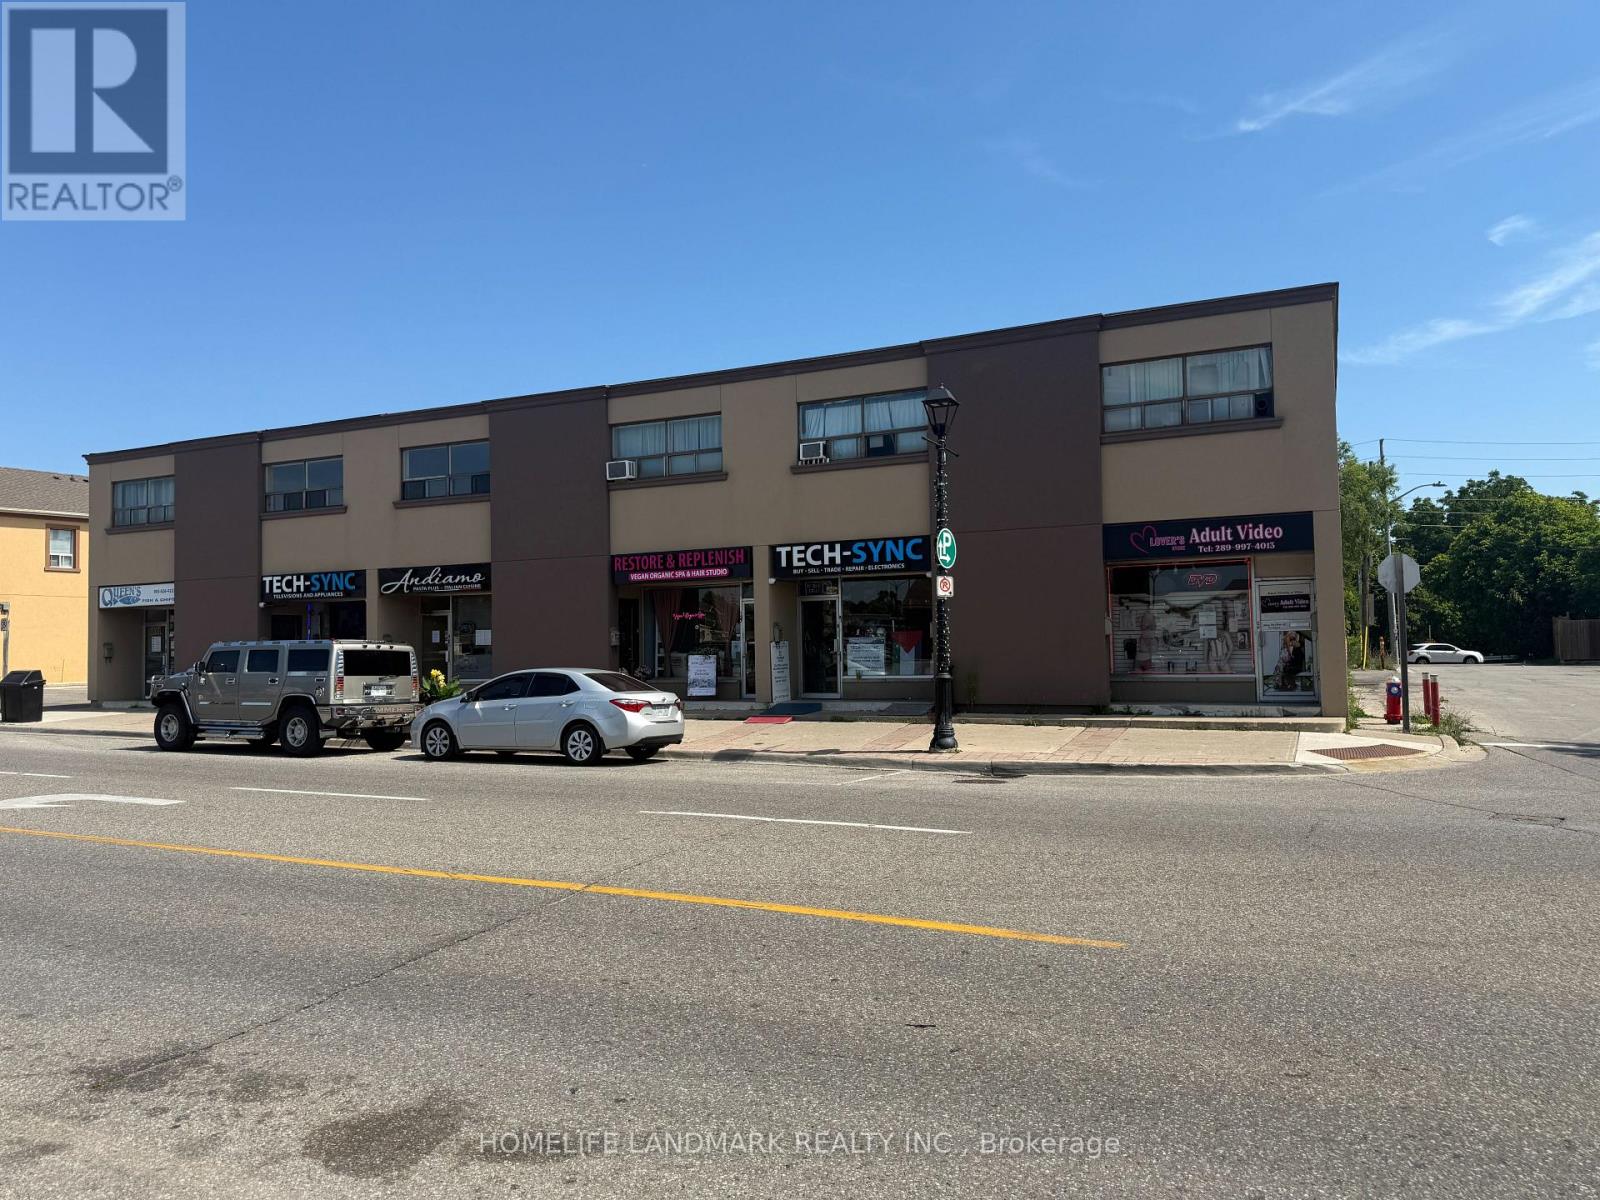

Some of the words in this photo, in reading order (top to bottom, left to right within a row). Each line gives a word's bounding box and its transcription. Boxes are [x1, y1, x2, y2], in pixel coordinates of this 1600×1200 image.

[1150, 535, 1185, 547] LOVER'S
[1189, 526, 1233, 544] Adult
[1236, 523, 1284, 540] Video
[614, 554, 664, 571] RESTORE
[666, 553, 675, 568] &
[678, 548, 745, 567] REPLENISH
[776, 538, 923, 568] TECH-SYNC
[1198, 545, 1214, 553] Tel:
[630, 573, 649, 581] VEGAN
[649, 571, 675, 580] ORGANIC
[675, 570, 686, 578] SPA
[691, 569, 705, 577] HAIR
[705, 568, 728, 576] STUDIO
[867, 562, 905, 571] ELECTRONICS
[262, 572, 356, 594] TECH-SYNC
[380, 566, 486, 594] Andiamo
[102, 586, 142, 607] QUEEN'S
